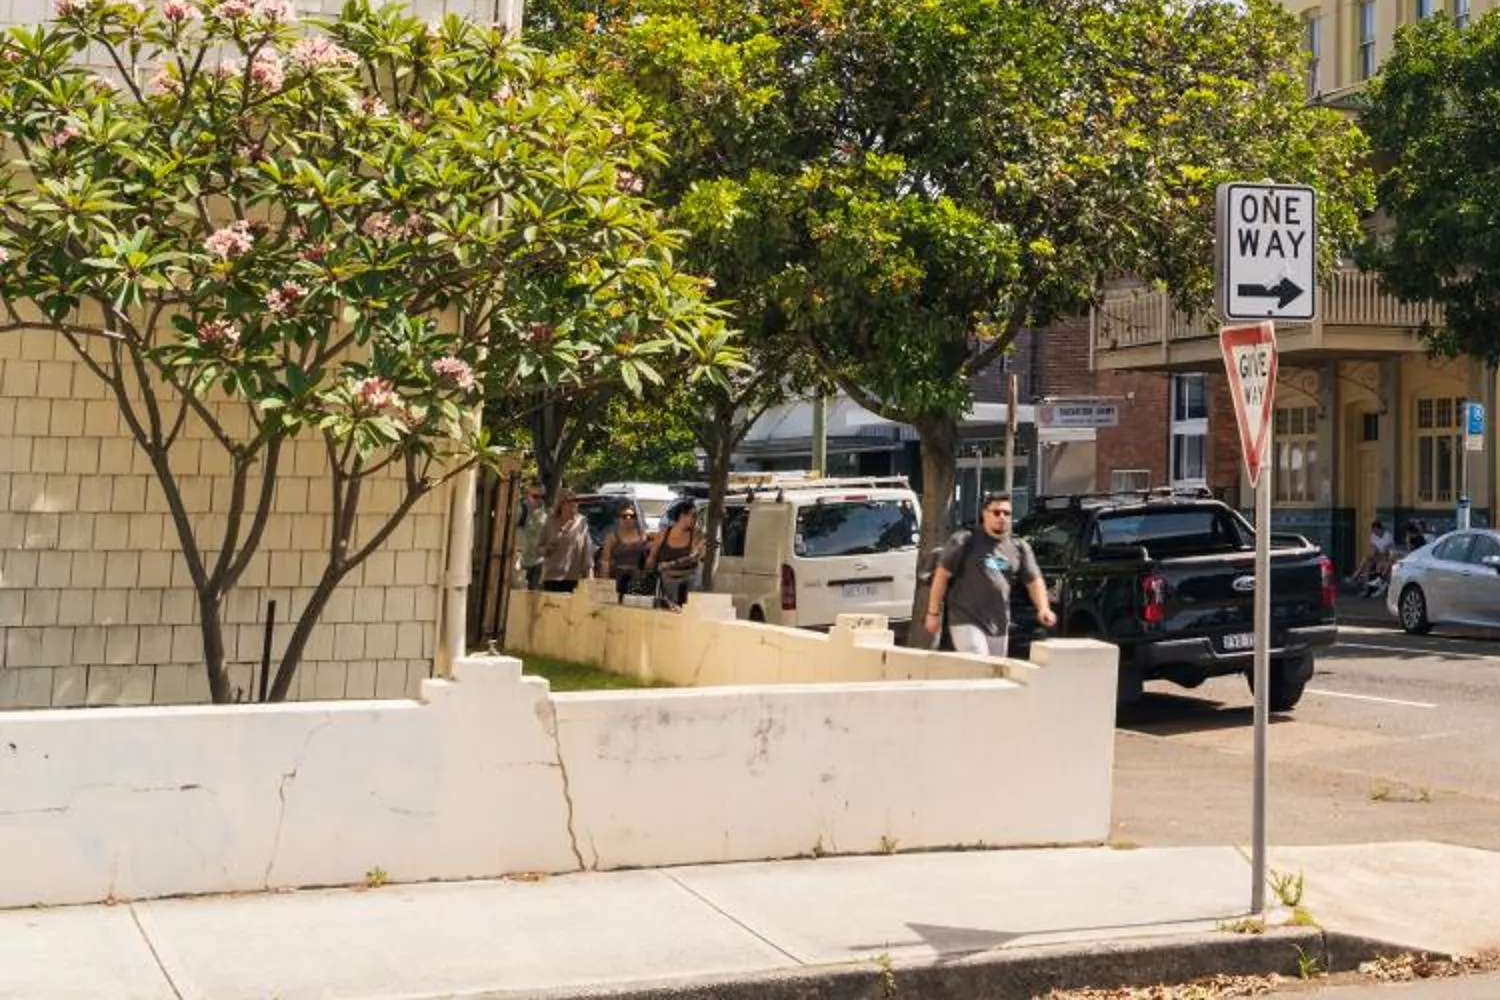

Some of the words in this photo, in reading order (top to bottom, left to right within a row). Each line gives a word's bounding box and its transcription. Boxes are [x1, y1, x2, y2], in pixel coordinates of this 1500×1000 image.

[1241, 194, 1301, 225] ONE
[1238, 228, 1305, 259] WAY
[1239, 352, 1267, 379] GIVE
[1245, 386, 1263, 405] WAY
